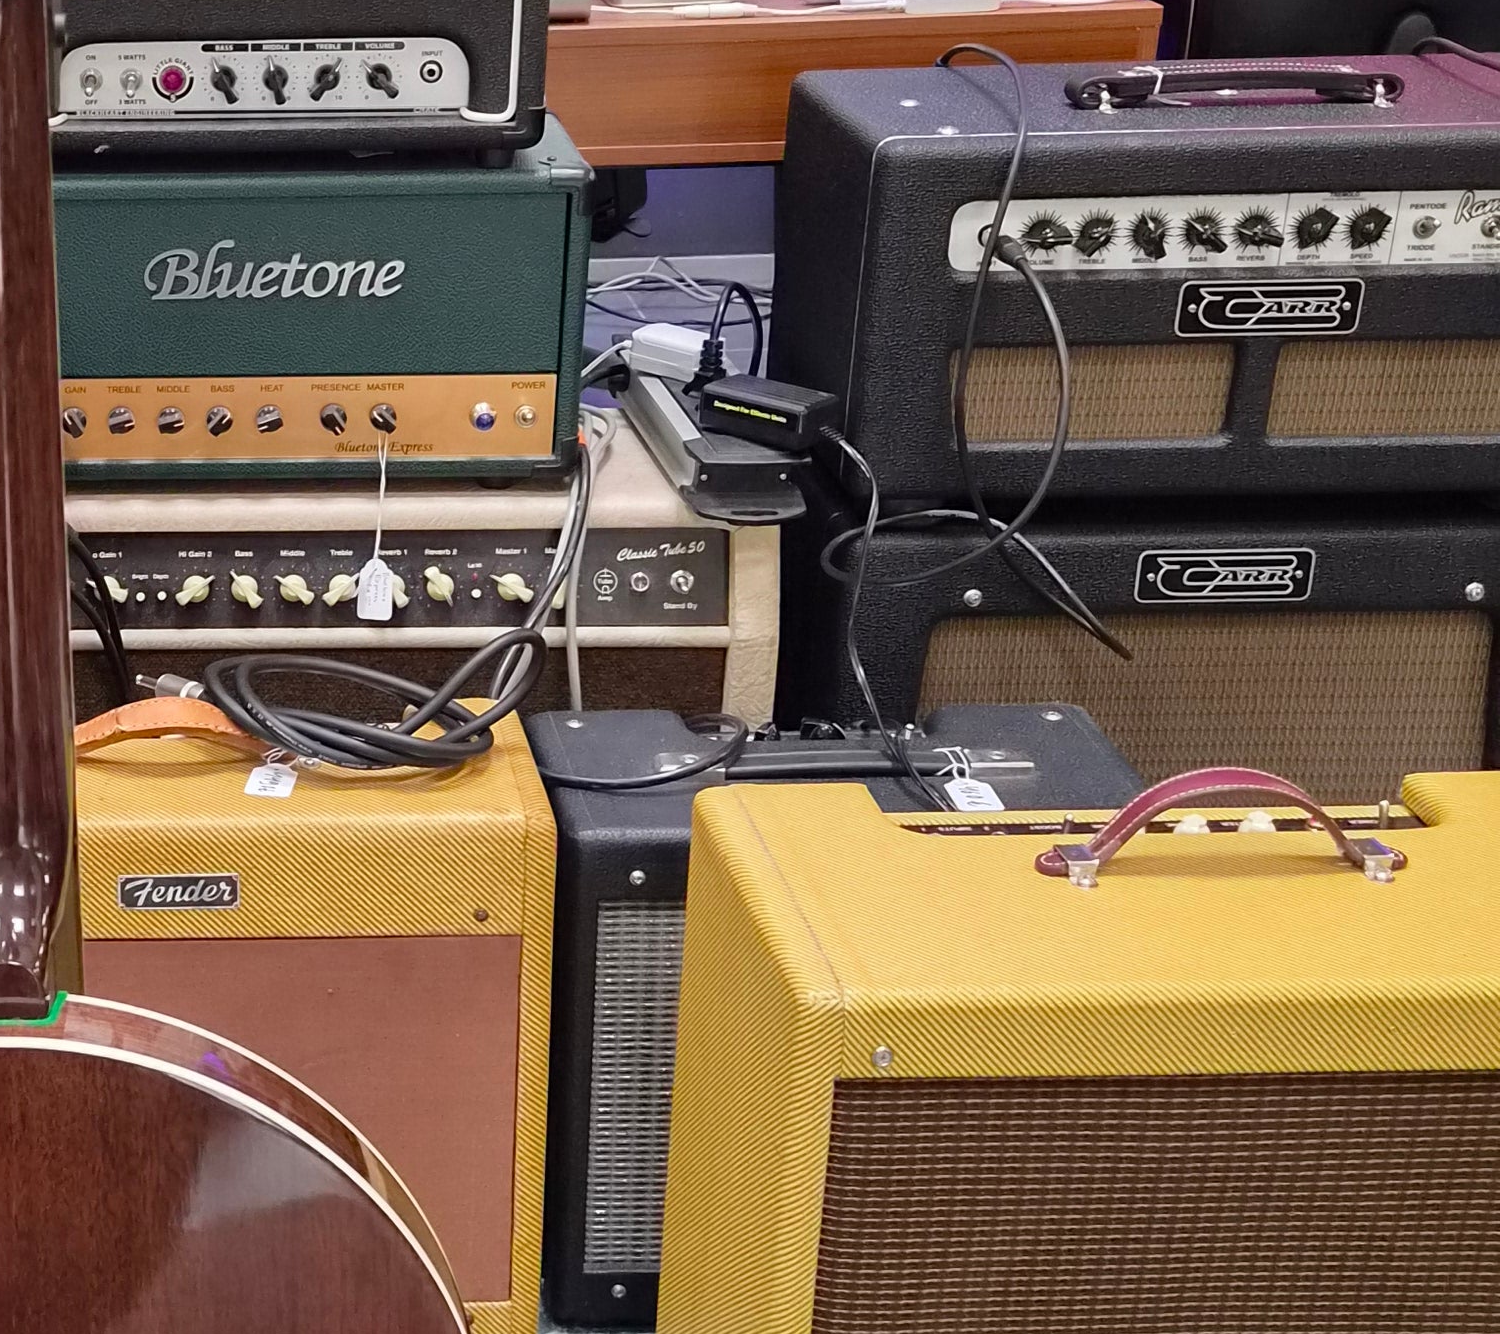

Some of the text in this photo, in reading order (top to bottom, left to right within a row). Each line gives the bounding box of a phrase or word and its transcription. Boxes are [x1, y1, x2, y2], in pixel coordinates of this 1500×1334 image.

[214, 44, 234, 52] BASS
[262, 43, 290, 51] MIDDLE
[315, 43, 342, 51] TREBLE
[364, 41, 395, 50] VOLUME
[152, 57, 194, 76] LITTLE GIANT
[143, 239, 405, 301] Bluetone
[106, 385, 142, 394] TREBLE
[156, 385, 191, 393] MIDDLE
[210, 384, 235, 393] BASS
[260, 384, 284, 392] HEAT
[310, 383, 361, 392] PRESENCE
[366, 382, 405, 391] MASTER
[511, 381, 546, 390] POWER
[64, 386, 87, 394] GAIN
[389, 440, 433, 454] Express
[99, 551, 117, 559] Gain
[234, 550, 254, 558] Bass
[330, 549, 354, 557] Treble
[424, 548, 451, 556] Reverb
[495, 547, 522, 555] Master
[616, 540, 706, 562] Classic Tube 50
[663, 602, 686, 610] Stand
[124, 878, 233, 907] Fender
